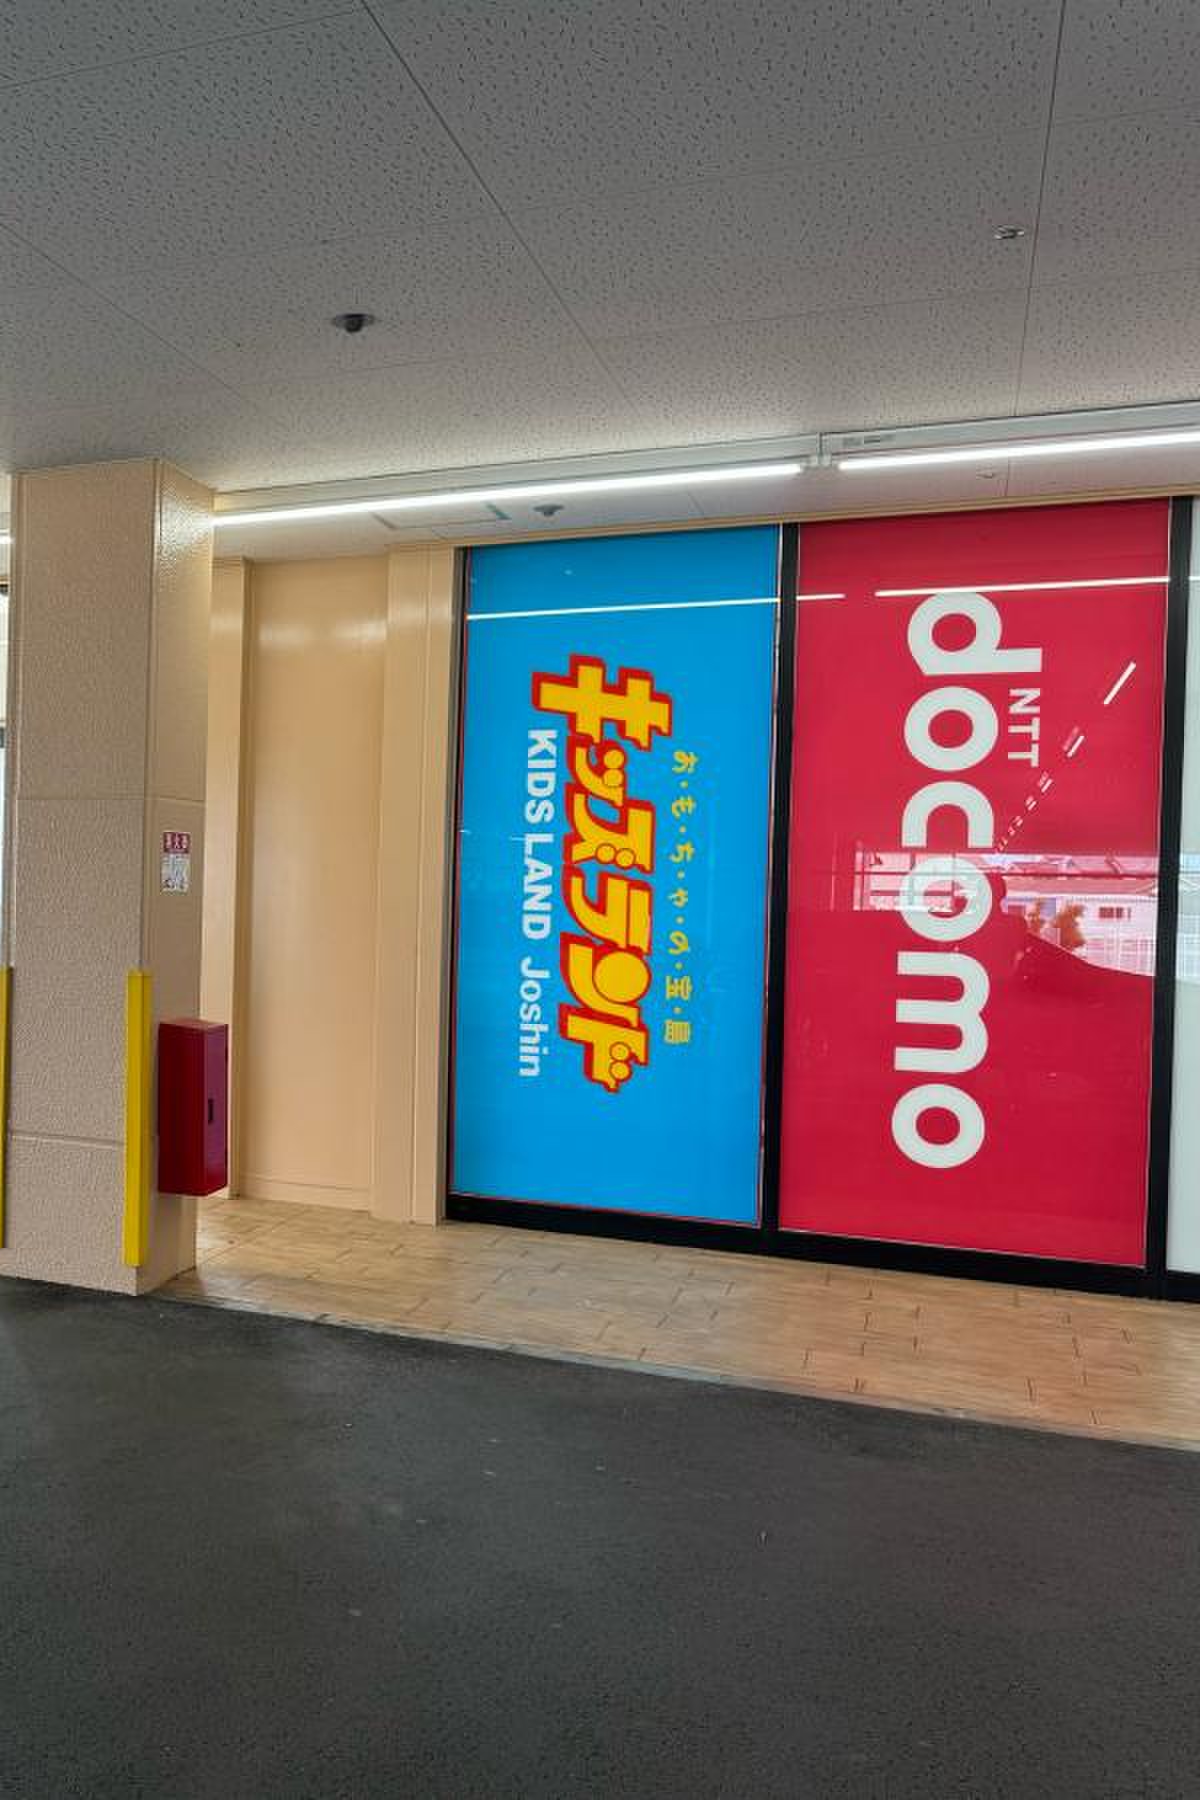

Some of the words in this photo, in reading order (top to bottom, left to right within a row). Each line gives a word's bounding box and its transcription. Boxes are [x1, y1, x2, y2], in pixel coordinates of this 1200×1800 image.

[524, 729, 557, 823] KIDS
[1008, 688, 1040, 767] NTT
[521, 834, 554, 941] LAND
[531, 654, 672, 1093] キッズランド
[892, 592, 1042, 1168] docomo
[519, 956, 550, 1077] Joshin
